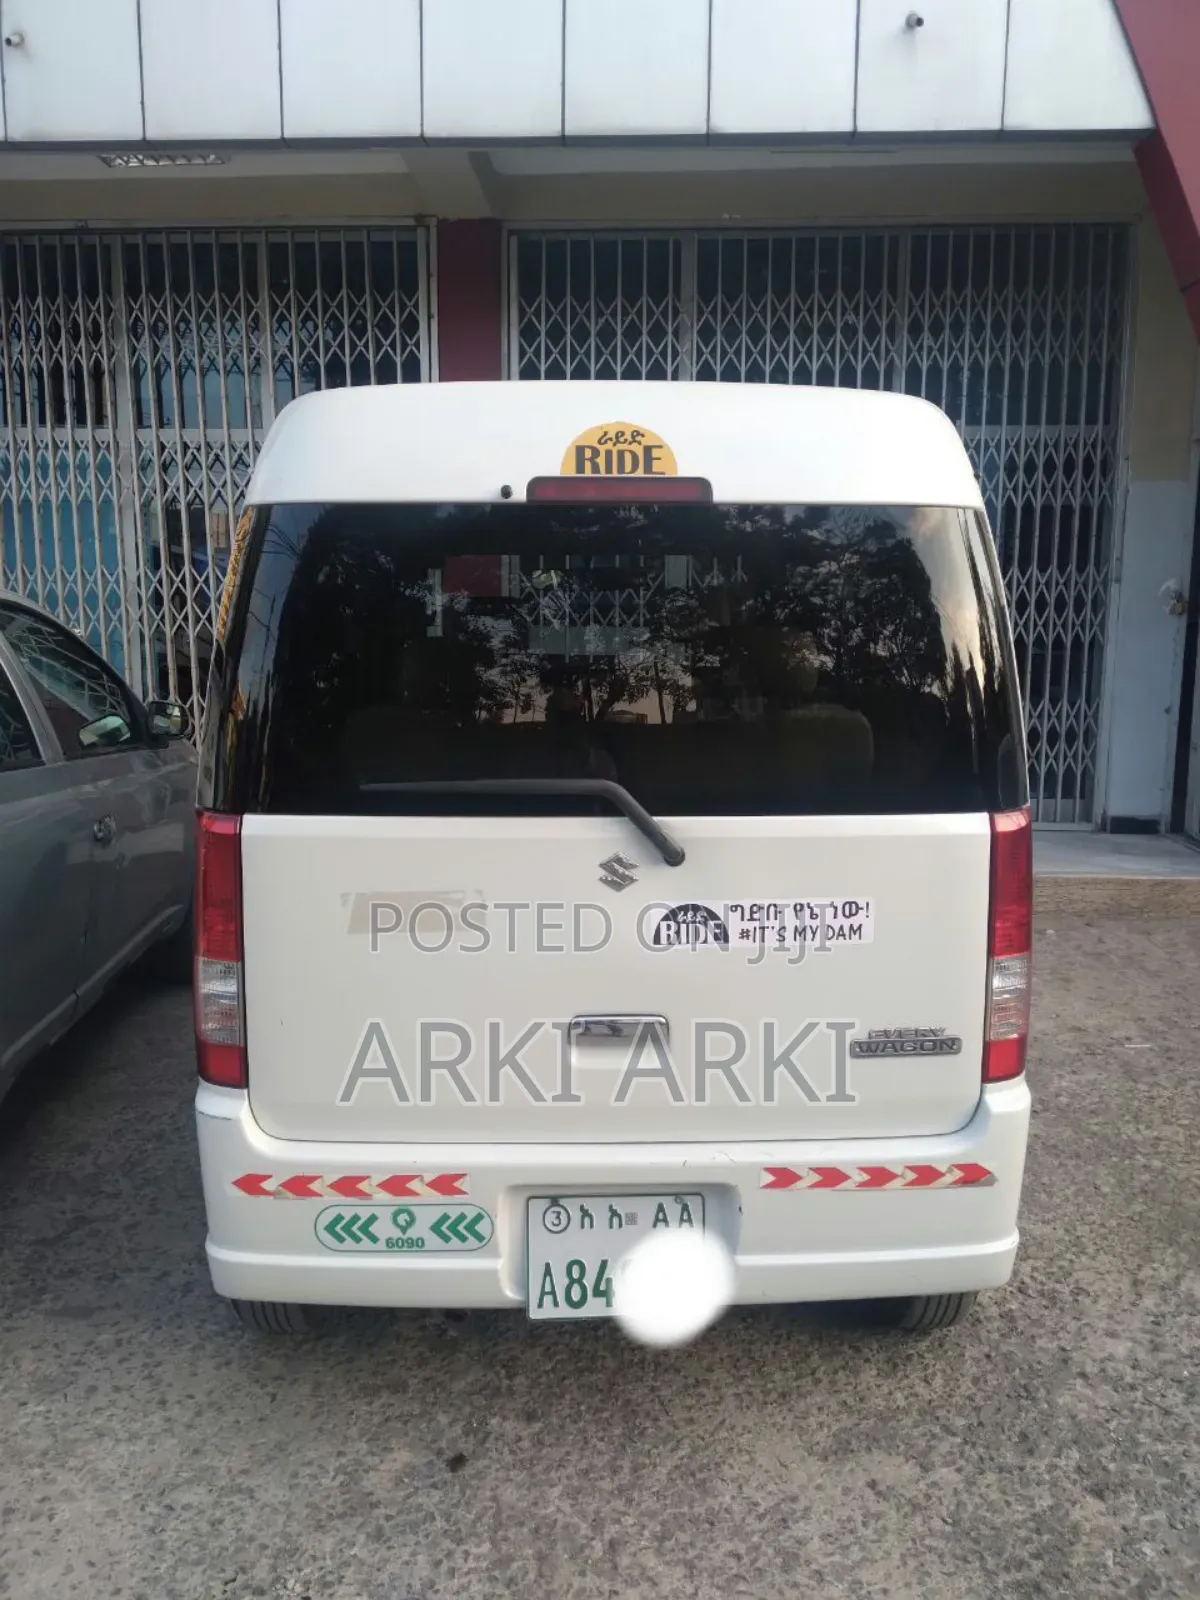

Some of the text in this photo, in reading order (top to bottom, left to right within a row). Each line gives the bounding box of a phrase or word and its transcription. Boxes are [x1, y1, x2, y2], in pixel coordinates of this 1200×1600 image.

[575, 444, 666, 476] RIDE
[738, 923, 864, 944] #IT'S MY DAM
[859, 1038, 957, 1054] WAGON
[385, 1236, 425, 1249] 6090
[537, 1259, 615, 1309] A84
